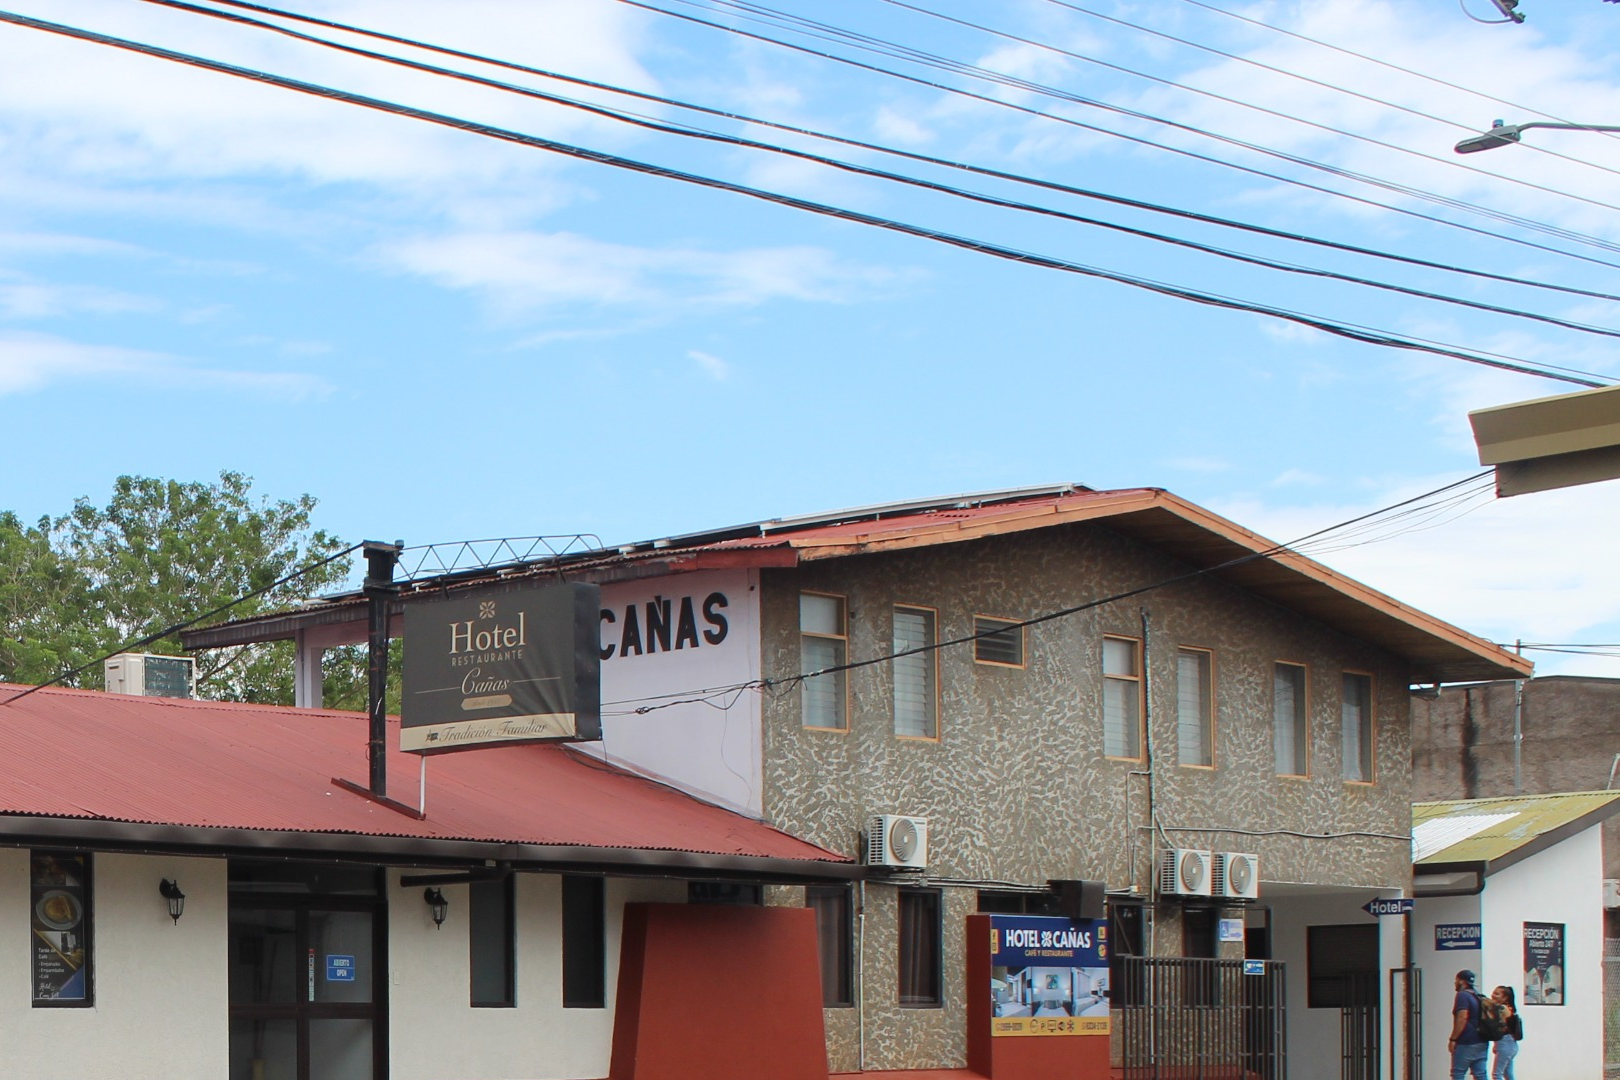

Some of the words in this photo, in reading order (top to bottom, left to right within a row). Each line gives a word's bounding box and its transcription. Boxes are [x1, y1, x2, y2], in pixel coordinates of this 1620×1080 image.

[449, 611, 526, 654] Hotel
[451, 650, 522, 667] RESTAURANTE
[461, 667, 510, 695] Cañas
[438, 724, 493, 741] Tradición
[496, 718, 547, 737] Familiar
[1370, 901, 1401, 914] Hotel
[1006, 930, 1040, 947] HOTEL
[1052, 928, 1090, 948] CAÑAS
